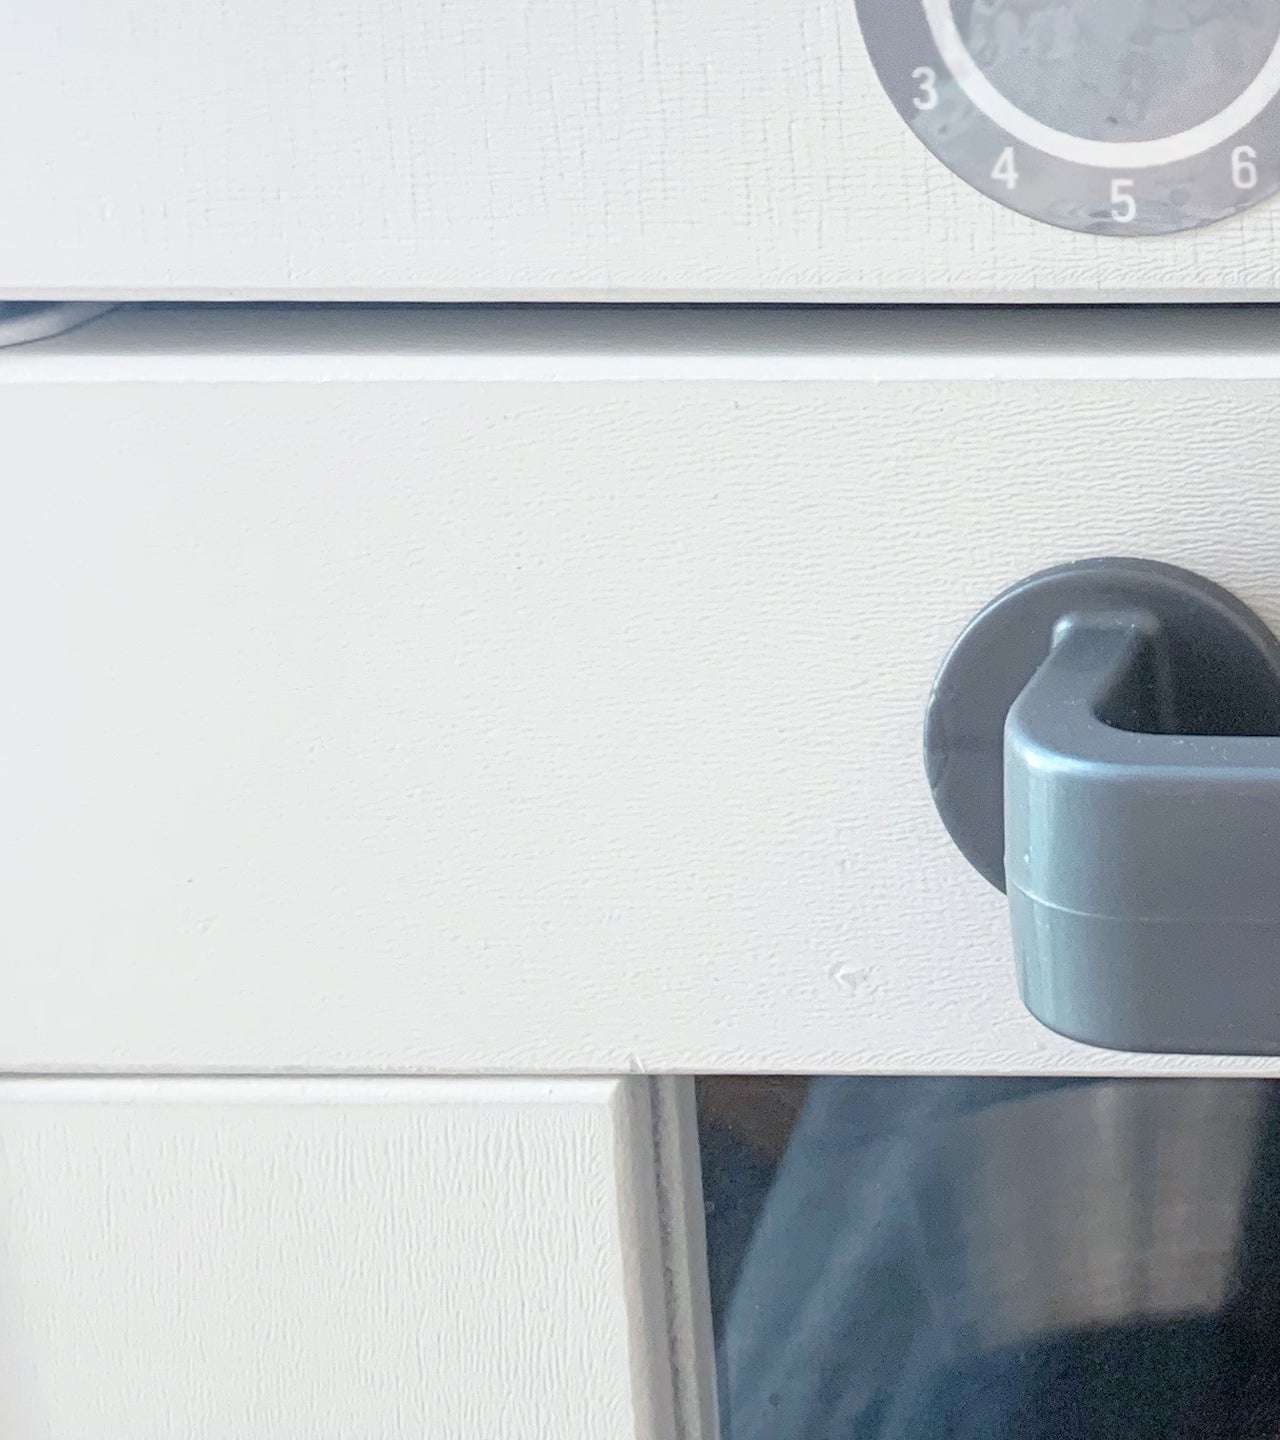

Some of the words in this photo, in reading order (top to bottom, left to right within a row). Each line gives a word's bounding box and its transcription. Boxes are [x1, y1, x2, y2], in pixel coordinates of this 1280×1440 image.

[911, 66, 938, 110] 3
[990, 146, 1019, 189] 4
[1230, 146, 1257, 189] 6
[1110, 180, 1136, 223] 5
